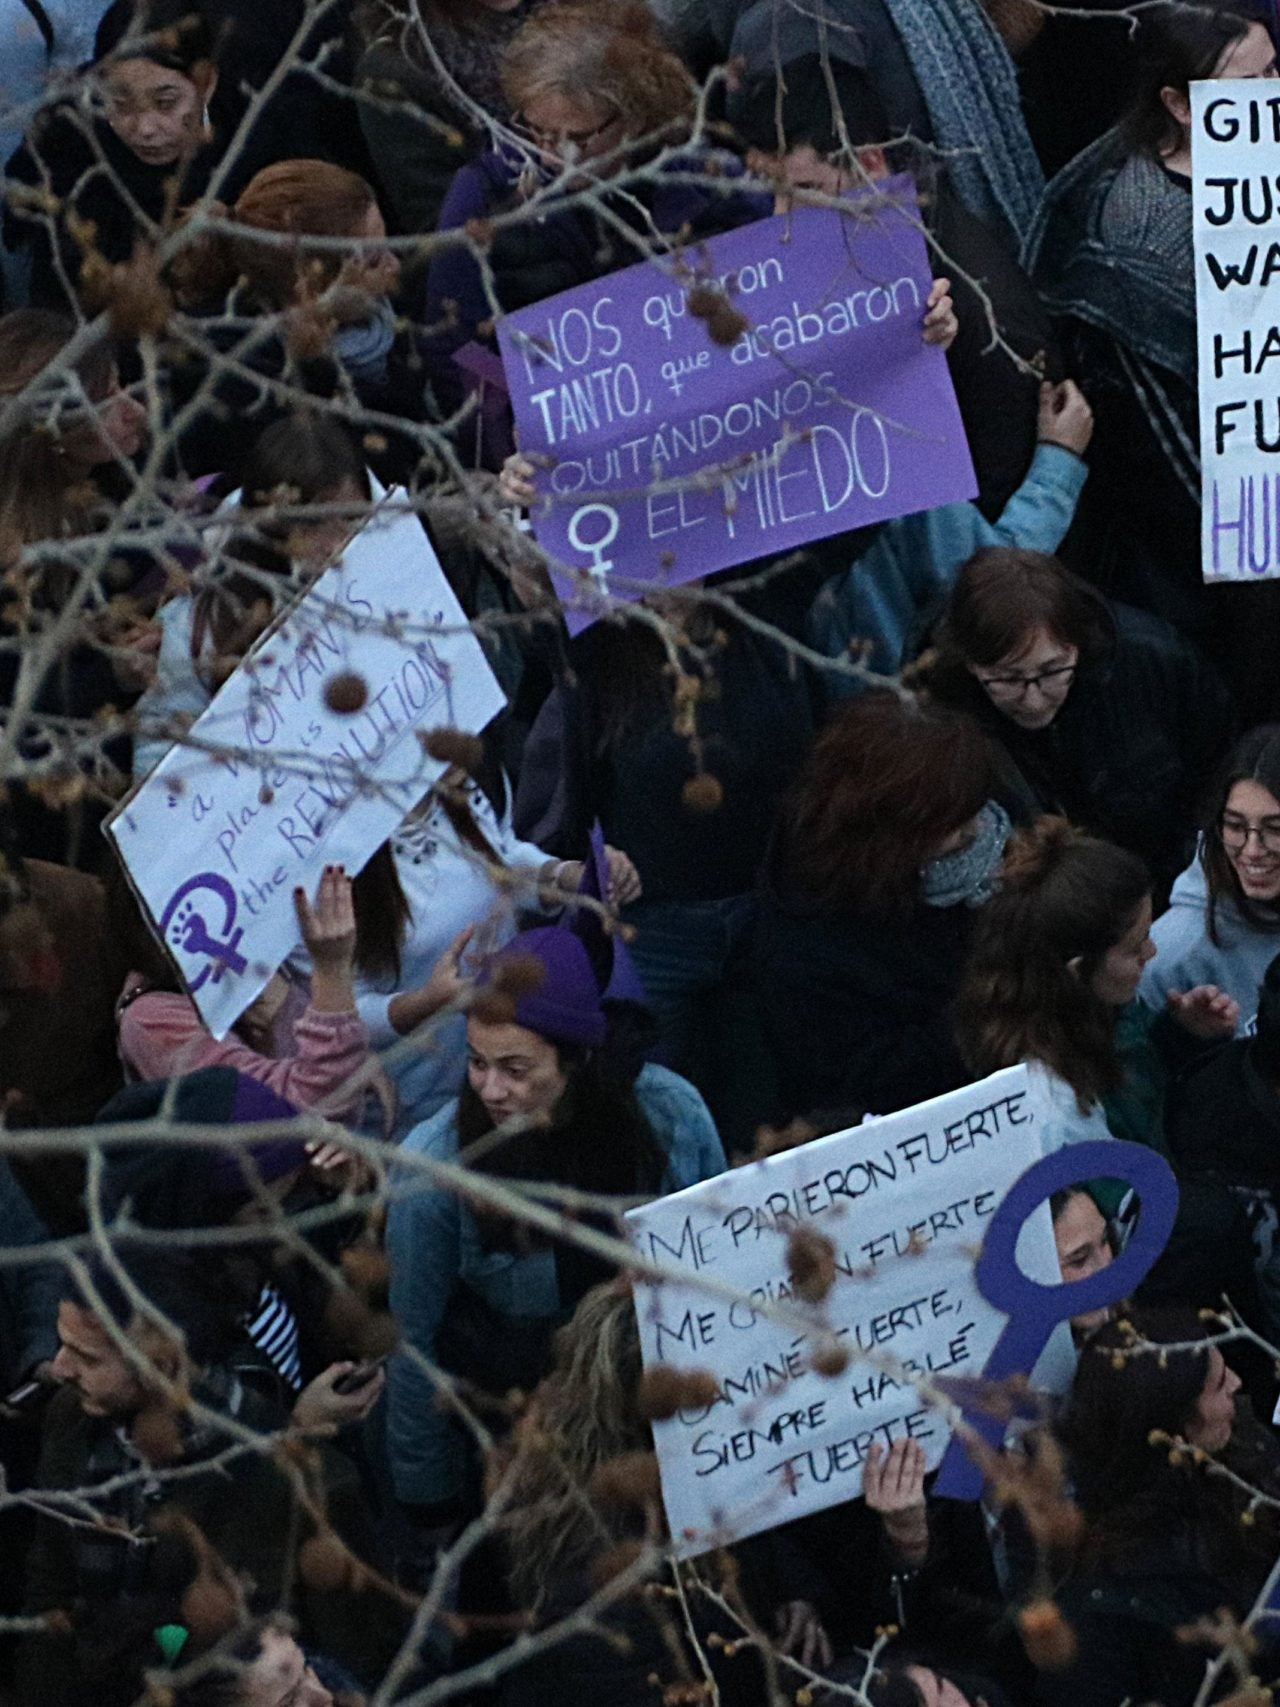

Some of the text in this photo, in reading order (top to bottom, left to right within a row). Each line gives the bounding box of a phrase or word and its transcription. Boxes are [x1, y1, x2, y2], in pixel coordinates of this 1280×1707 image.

[517, 297, 622, 385] NOS
[661, 350, 710, 397] que
[730, 276, 920, 366] acabaron
[551, 371, 835, 494] QUITÁNDONOS
[648, 409, 890, 539] EL MIEDO
[217, 767, 288, 872] plae
[243, 864, 289, 917] the
[647, 1091, 1035, 1271] ME PARIERON FUERTE,
[656, 1310, 716, 1360] ME
[862, 1190, 996, 1270] FUERTE
[852, 1322, 977, 1406] HABLÉ
[767, 1408, 935, 1497] FUERTE
